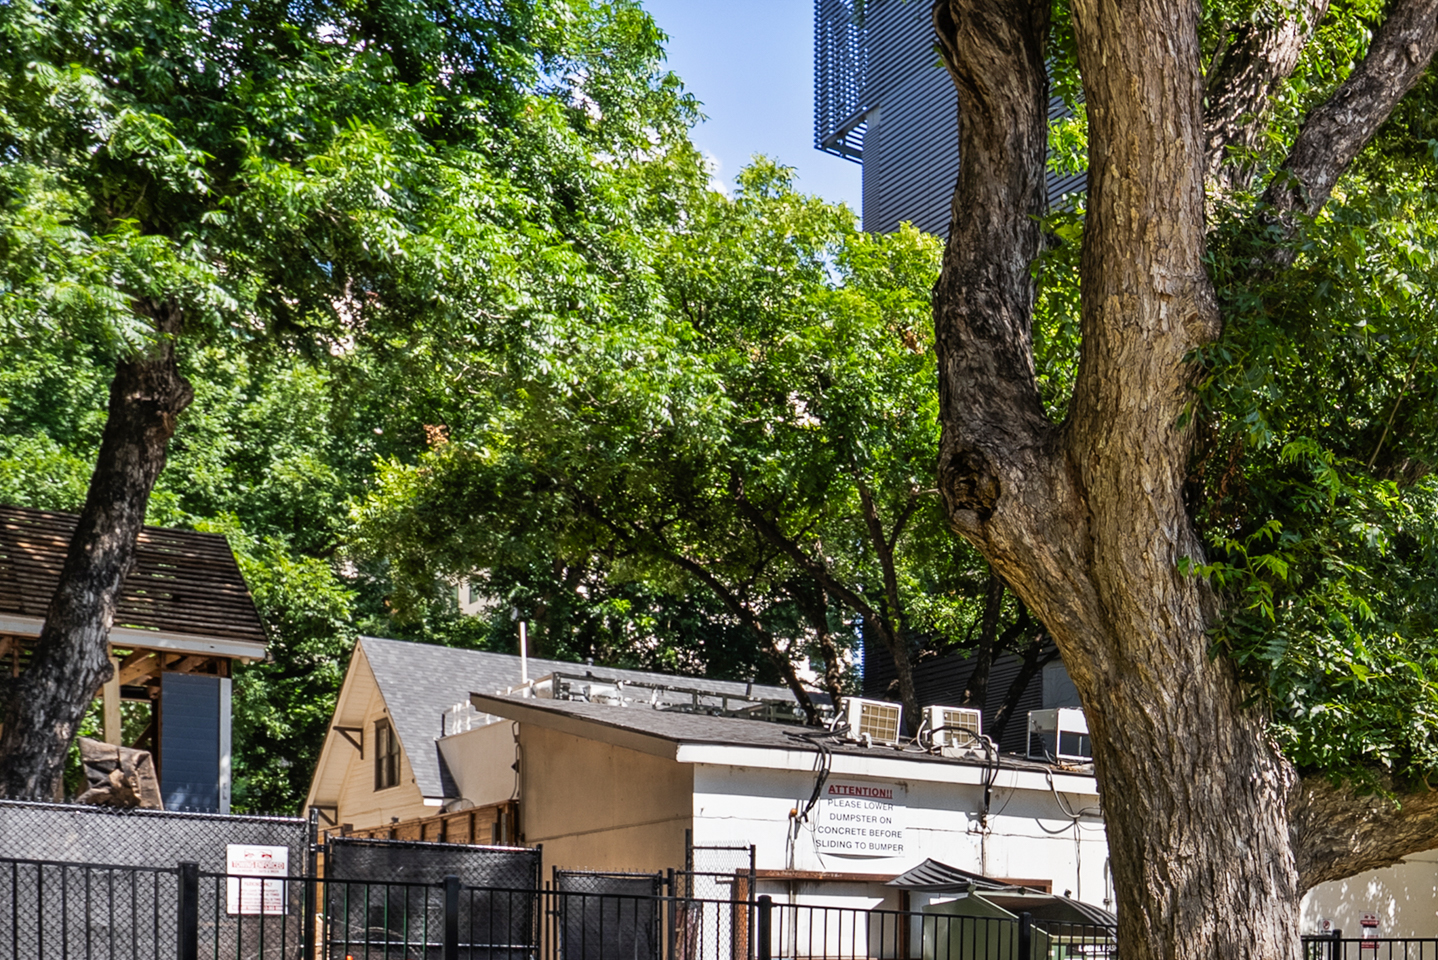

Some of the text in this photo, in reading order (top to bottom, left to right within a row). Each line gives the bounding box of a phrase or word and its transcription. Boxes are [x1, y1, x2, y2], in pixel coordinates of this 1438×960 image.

[828, 785, 893, 798] ATTENTION!!
[828, 799, 894, 811] PLEASE LOWER
[829, 813, 892, 824] DUMPSTER ON
[818, 826, 902, 838] CONCRETE BEFORE
[816, 840, 904, 851] SLIDING TO BUMPER
